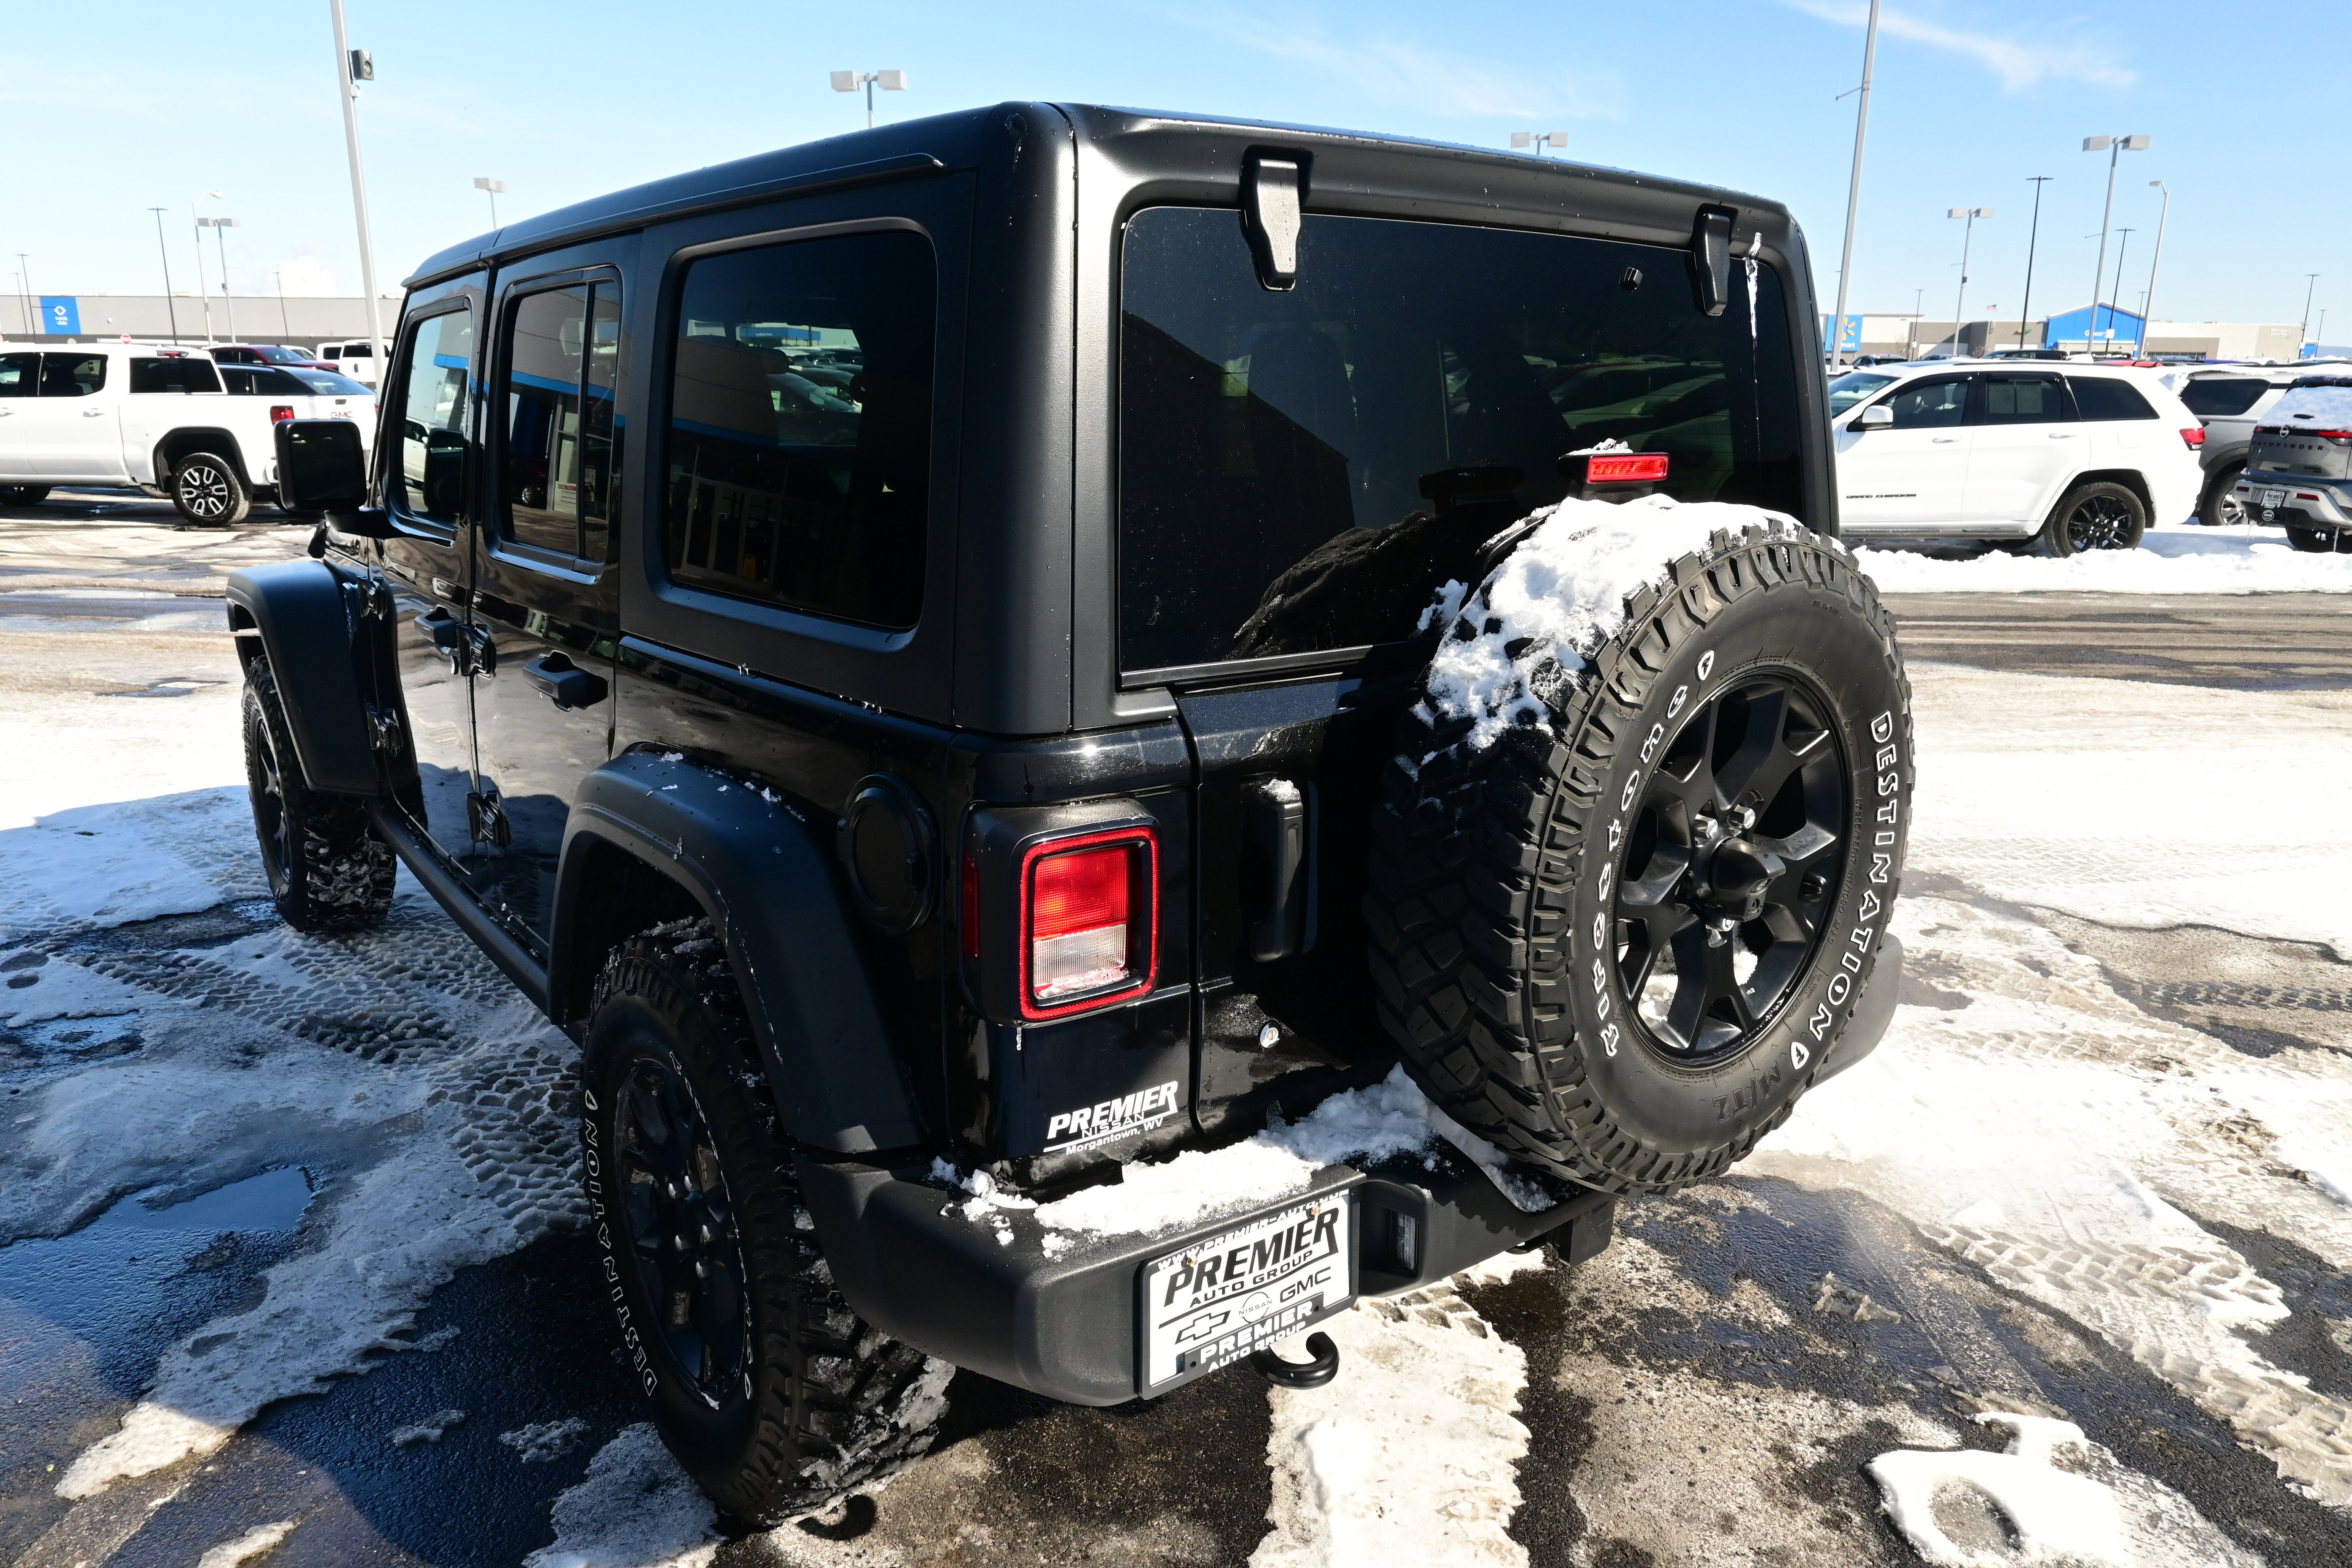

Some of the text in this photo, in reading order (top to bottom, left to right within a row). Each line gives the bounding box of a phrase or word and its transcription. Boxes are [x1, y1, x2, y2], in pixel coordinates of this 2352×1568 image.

[1808, 710, 1899, 1041] DESTINATION
[1047, 1081, 1178, 1139] PREMIER
[1066, 1117, 1163, 1155] Morgantown, WV
[1082, 1111, 1145, 1138] NISSAN
[585, 1118, 657, 1396] DESTINATION
[1164, 1207, 1339, 1307] PREMIER
[1190, 1250, 1313, 1308] AUTO GROUP
[1239, 1266, 1331, 1316] NISSAN GMC
[1200, 1301, 1312, 1364] PREMIER
[1207, 1321, 1306, 1372] AUTO GROUP
